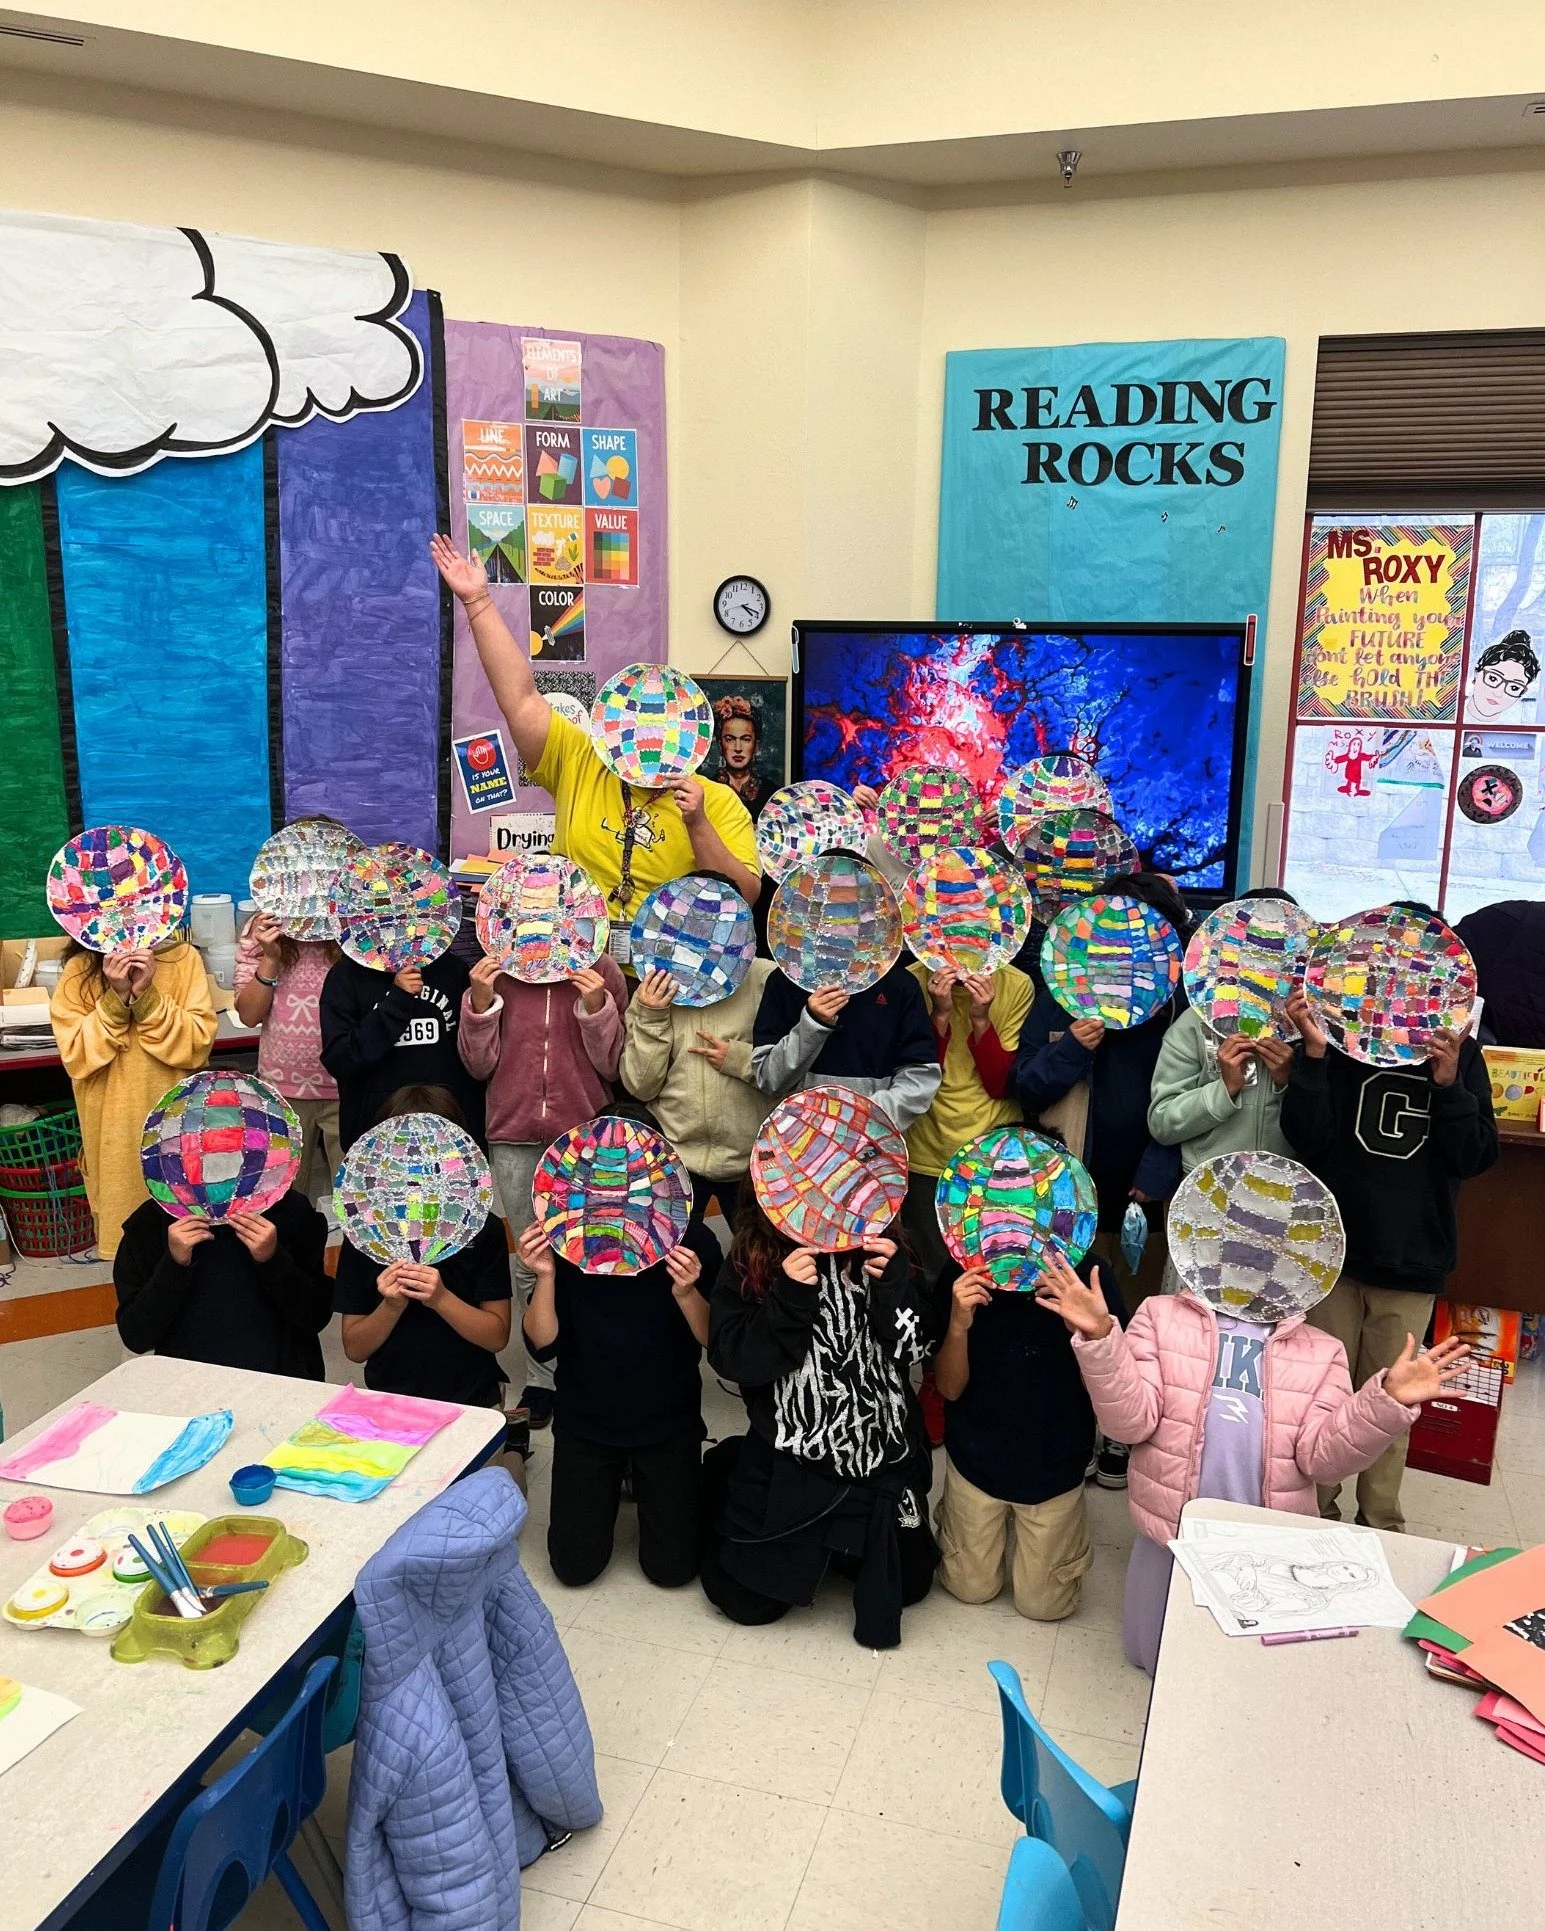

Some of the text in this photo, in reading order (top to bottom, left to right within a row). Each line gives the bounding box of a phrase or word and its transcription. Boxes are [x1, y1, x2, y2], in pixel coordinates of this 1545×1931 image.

[526, 346, 578, 361] ELEMENTS
[546, 368, 559, 381] OF
[543, 388, 562, 402] ART
[972, 377, 1277, 431] READING
[480, 428, 504, 445] LINE
[535, 431, 570, 448] FORM
[591, 434, 626, 451] SHAPE
[1021, 441, 1245, 487] ROCKS
[479, 511, 514, 527] SPACE
[531, 512, 580, 529] TEXTURE
[595, 513, 628, 530] VALUE
[1327, 529, 1381, 559] MS.
[1362, 554, 1445, 586] ROXY
[740, 582, 748, 591] 12
[538, 590, 575, 607] COLOR
[725, 591, 733, 600] 10
[1359, 585, 1418, 607] When
[1315, 606, 1463, 630] Painting your
[1350, 629, 1427, 648] FUTURE
[1355, 649, 1385, 666] let
[1389, 652, 1461, 671] anyone
[1301, 668, 1340, 688] else
[1415, 669, 1450, 689] THE
[1487, 741, 1530, 750] WELCOME
[472, 768, 501, 781] IS YOUR
[470, 776, 507, 794] NAME
[475, 788, 508, 804] ON THAT?
[1354, 1070, 1431, 1159] G
